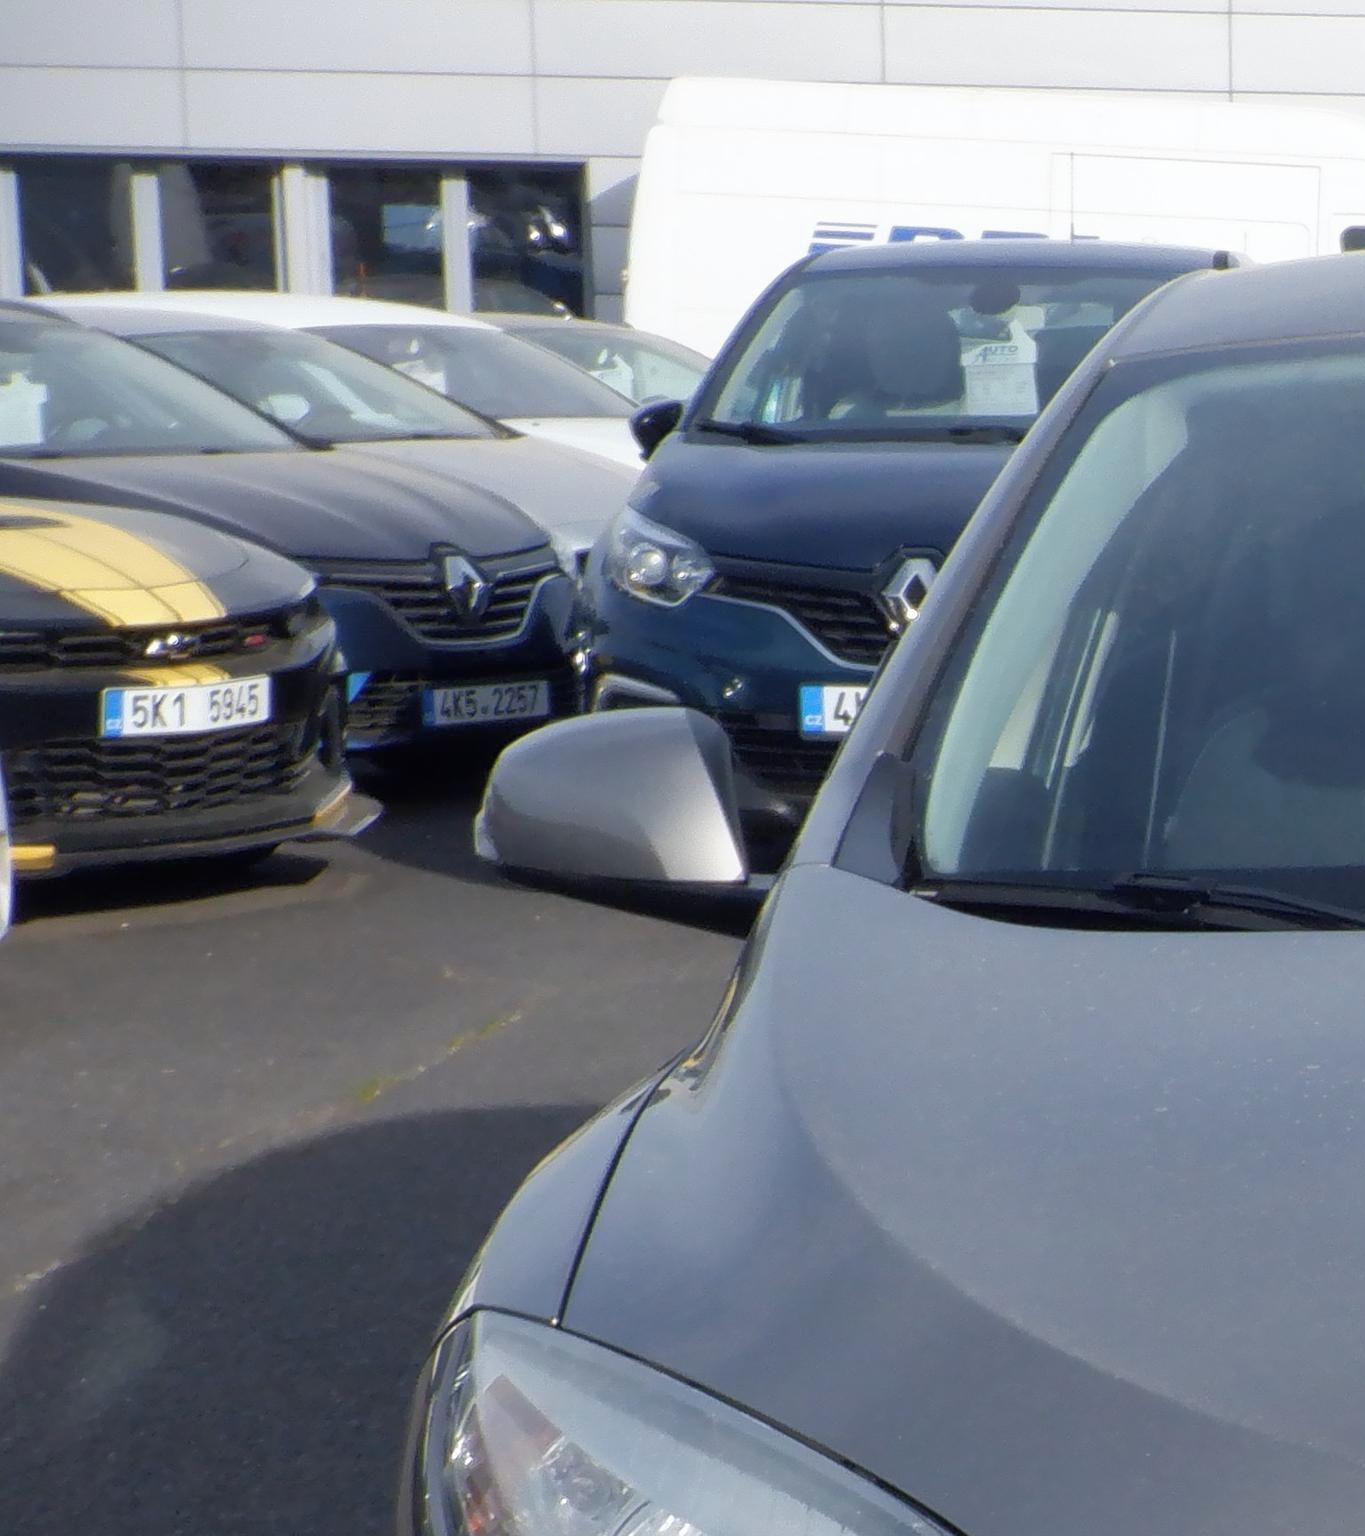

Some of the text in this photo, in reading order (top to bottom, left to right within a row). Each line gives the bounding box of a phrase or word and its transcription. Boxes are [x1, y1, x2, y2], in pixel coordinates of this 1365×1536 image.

[132, 684, 259, 729] 5K1 5945
[440, 685, 538, 718] 4K5 2257
